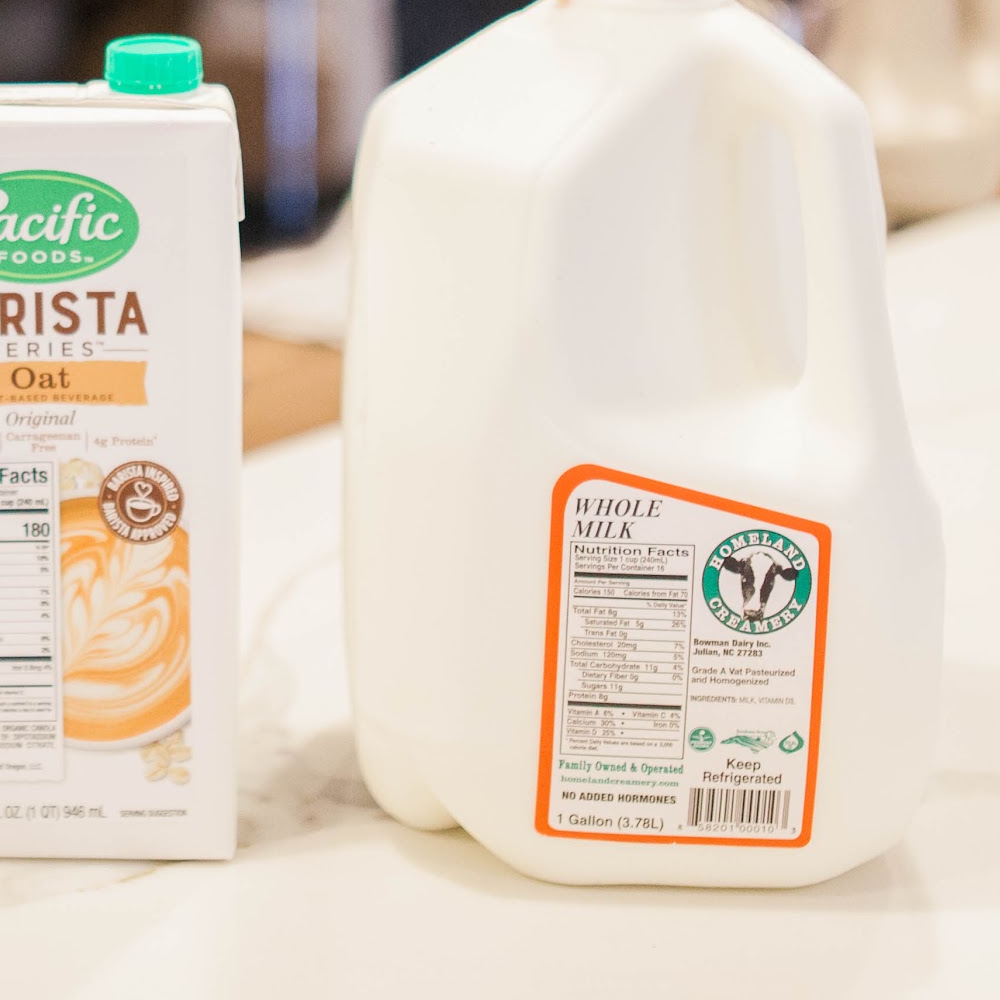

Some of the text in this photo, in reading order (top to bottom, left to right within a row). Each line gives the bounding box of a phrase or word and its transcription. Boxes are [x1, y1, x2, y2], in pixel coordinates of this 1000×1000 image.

[11, 366, 70, 390] Oat
[53, 393, 114, 403] BEVERAGE
[6, 410, 76, 428] Original
[6, 432, 81, 444] Carrageenan
[31, 443, 56, 453] Free
[0, 467, 48, 484] Facts
[575, 498, 663, 518] WHOLE
[23, 522, 50, 538] 180
[572, 520, 636, 539] MILK
[574, 545, 690, 557] Nutrition Facts
[708, 532, 806, 571] HOMELAND
[575, 554, 602, 563] Serving
[626, 556, 639, 564] cup
[640, 556, 668, 565] (240mL)
[575, 563, 605, 571] Servings
[621, 564, 655, 572] Container
[573, 587, 601, 595] Calories
[623, 589, 651, 597] Calories
[573, 607, 591, 615] Total
[593, 608, 606, 616] Fat
[708, 597, 803, 633] CREAMERY
[584, 618, 617, 627] Saturated
[635, 620, 644, 629] 5g
[584, 629, 604, 637] Trans
[605, 630, 617, 638] Fat
[571, 639, 637, 650] Cholesterol 20mg
[693, 638, 771, 649] Bowman Dairy Inc.
[570, 649, 627, 661] Sodium 120mg
[692, 648, 763, 658] Julian, NC 27283
[570, 661, 658, 673] Total Carbohydrate 11g
[691, 666, 796, 677] Grade A Vat Pasteurized
[582, 671, 607, 680] Dietary
[609, 672, 630, 680] Fiber
[581, 682, 623, 692] Sugars 11g
[691, 676, 769, 687] and Homogenized
[568, 691, 596, 700] Protein
[567, 708, 593, 716] Vitamin
[632, 711, 659, 719] Vitamin
[567, 718, 596, 726] Calcium
[653, 721, 668, 729] Iron
[567, 728, 591, 736] Vitamin
[559, 759, 684, 775] Family Owned & Operated
[726, 758, 761, 773] Keep
[561, 775, 679, 788] homelandcreamery.com
[702, 772, 783, 786] Refrigerated
[562, 791, 677, 805] NO ADDED HORMONES
[63, 804, 85, 819] 946
[557, 813, 664, 831] 1 Gallon (3.78L)
[698, 823, 775, 834] 58201 00010
